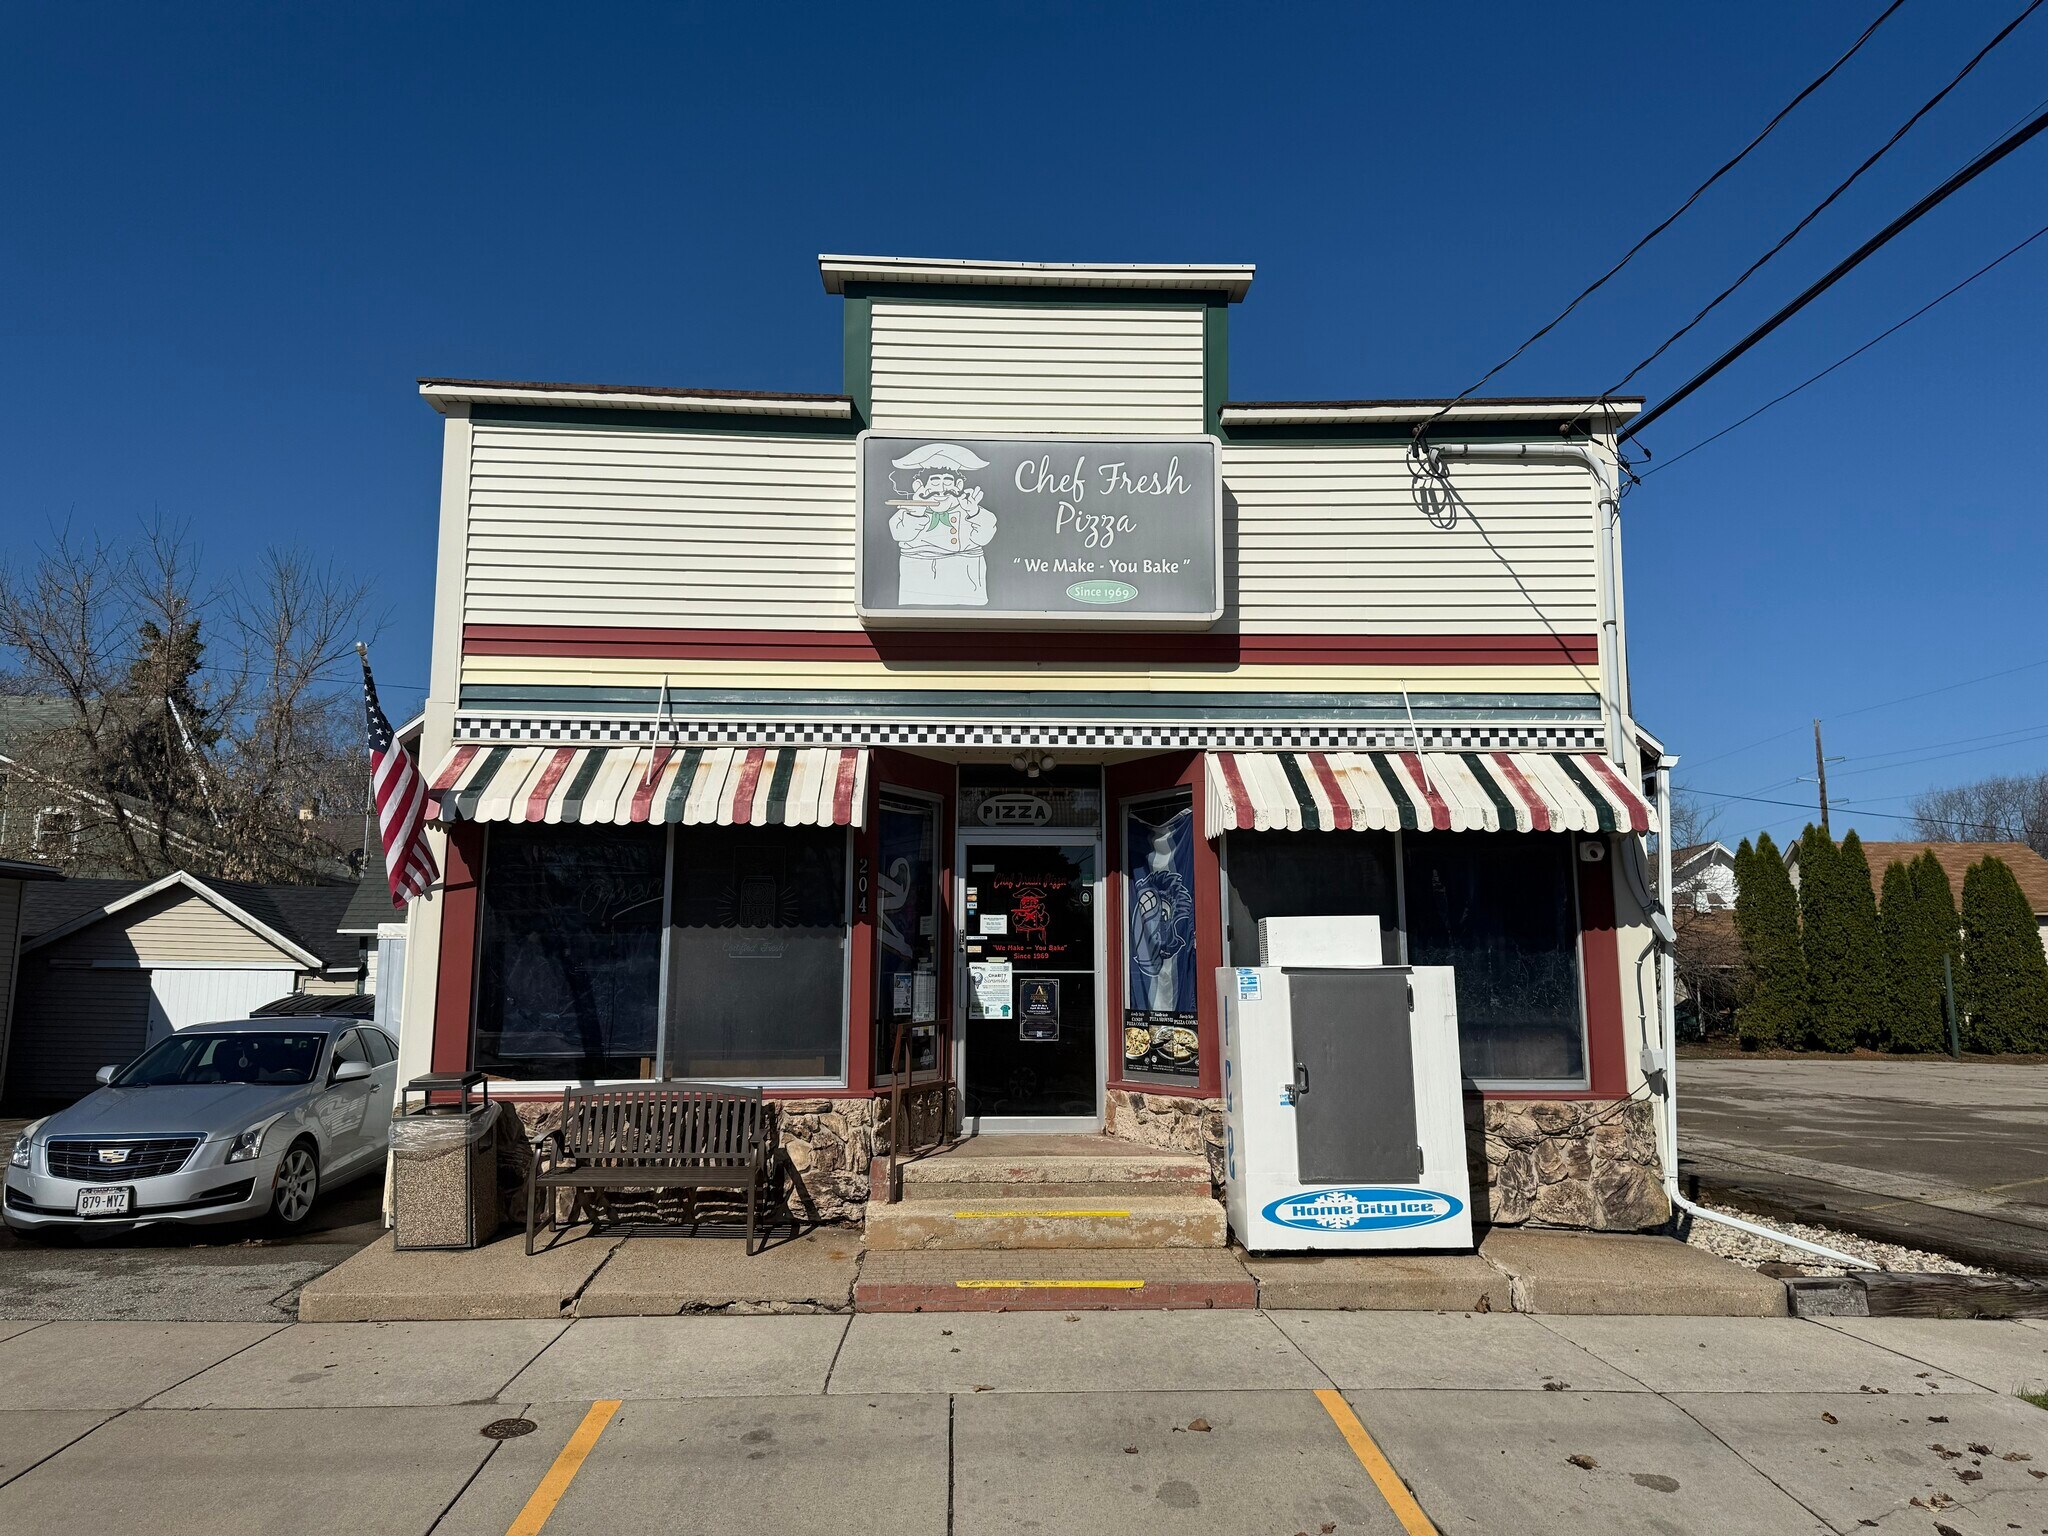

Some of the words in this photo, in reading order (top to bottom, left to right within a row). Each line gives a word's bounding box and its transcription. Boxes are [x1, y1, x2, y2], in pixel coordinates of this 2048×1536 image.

[1014, 455, 1086, 503] Chef
[1097, 455, 1192, 496] Fresh
[1055, 501, 1137, 548] Pizza
[1053, 558, 1095, 573] Make
[1108, 559, 1138, 574] You
[1074, 586, 1102, 598] Since
[1103, 587, 1130, 600] 1969
[983, 806, 1046, 819] PIZZA
[858, 858, 868, 913] 204
[82, 1194, 125, 1209] 879-MYZ
[1292, 1204, 1353, 1217] Home
[1356, 1203, 1398, 1216] City
[1400, 1202, 1433, 1213] Ice
